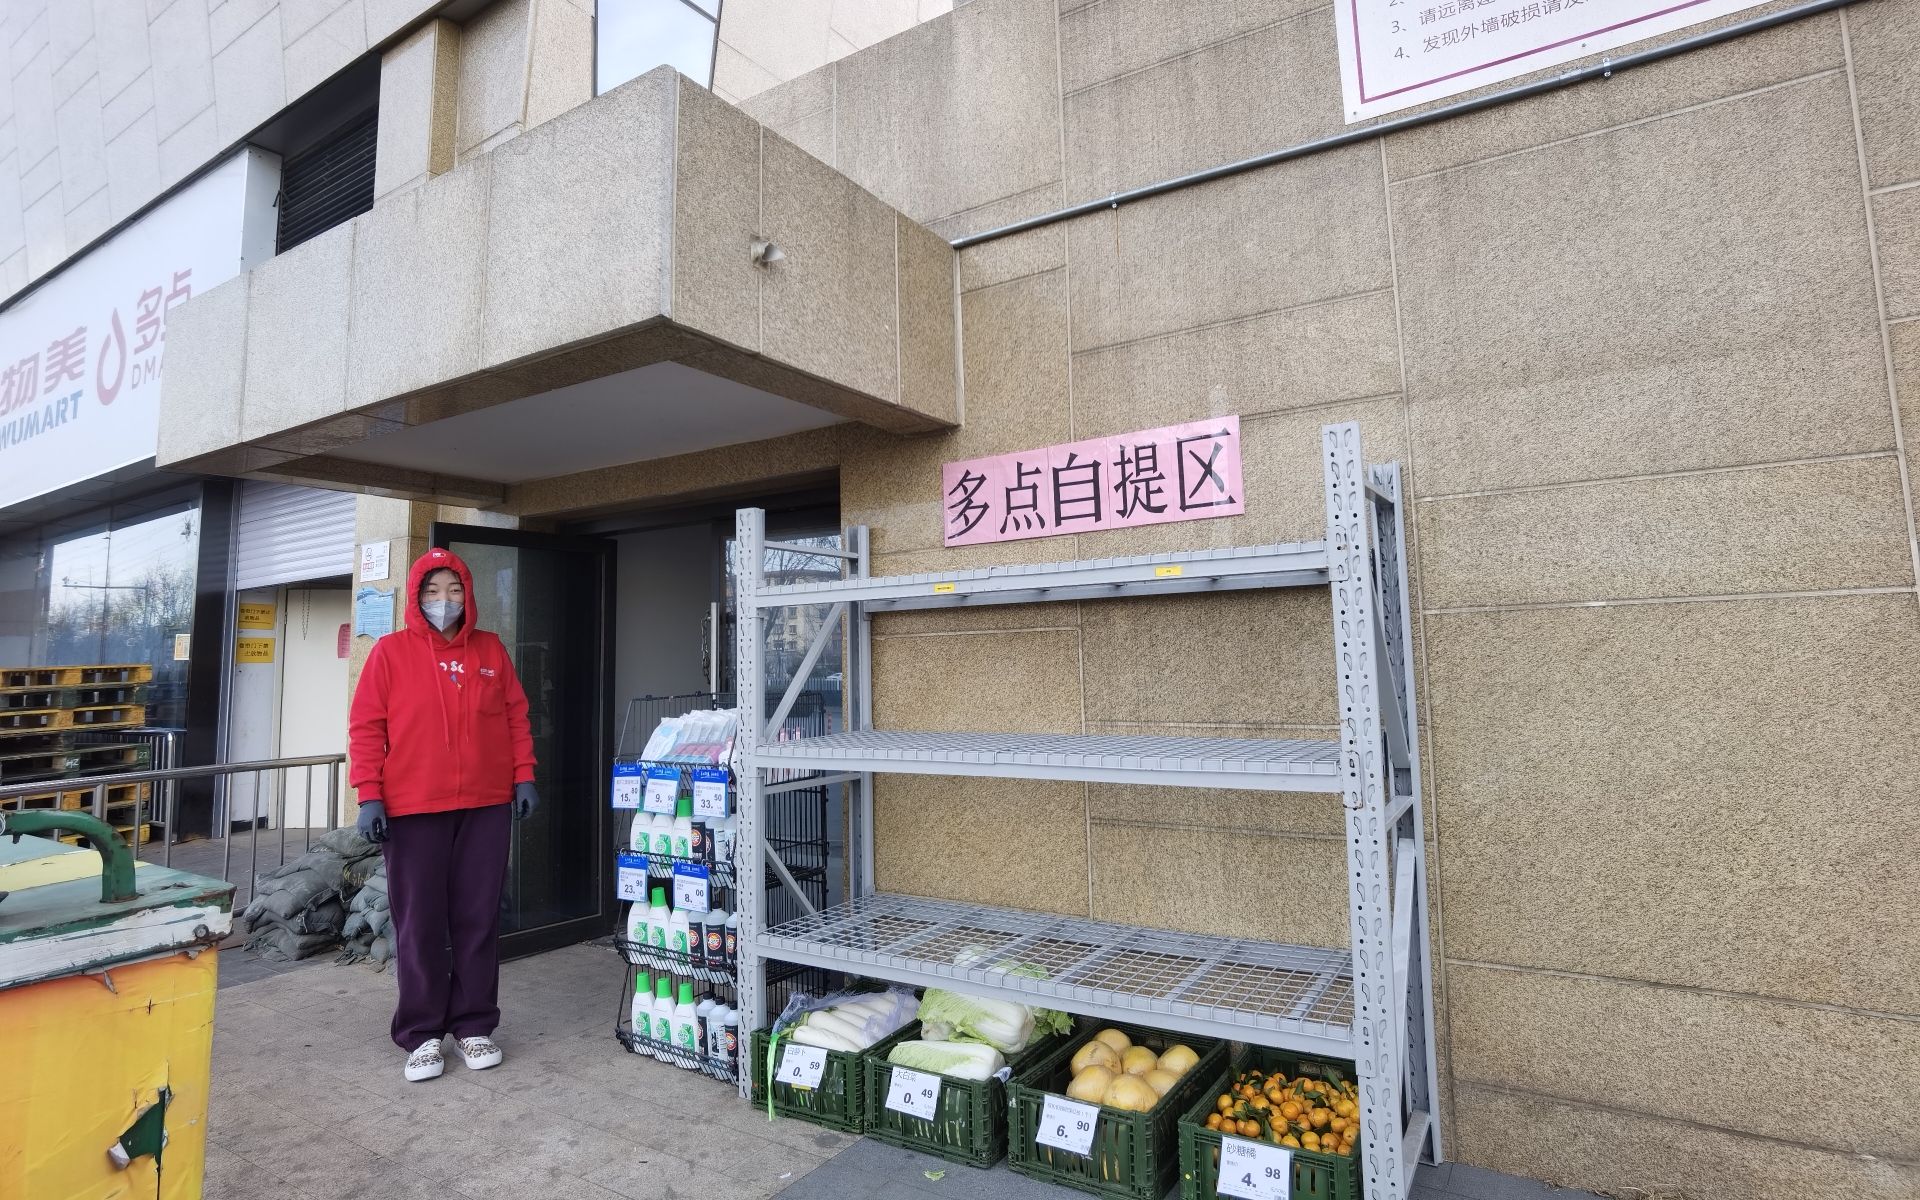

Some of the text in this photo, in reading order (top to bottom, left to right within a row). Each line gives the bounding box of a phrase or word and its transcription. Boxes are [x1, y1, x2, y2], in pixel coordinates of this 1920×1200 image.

[0, 325, 88, 417] 物美
[948, 427, 1236, 540] 多点自提区
[700, 799, 714, 809] 33.
[624, 884, 636, 895] 23.
[793, 1061, 820, 1078] 0. 59
[903, 1088, 933, 1105] 0. 49
[1056, 1120, 1090, 1138] 6. 90
[1241, 1166, 1281, 1188] 4. 98
